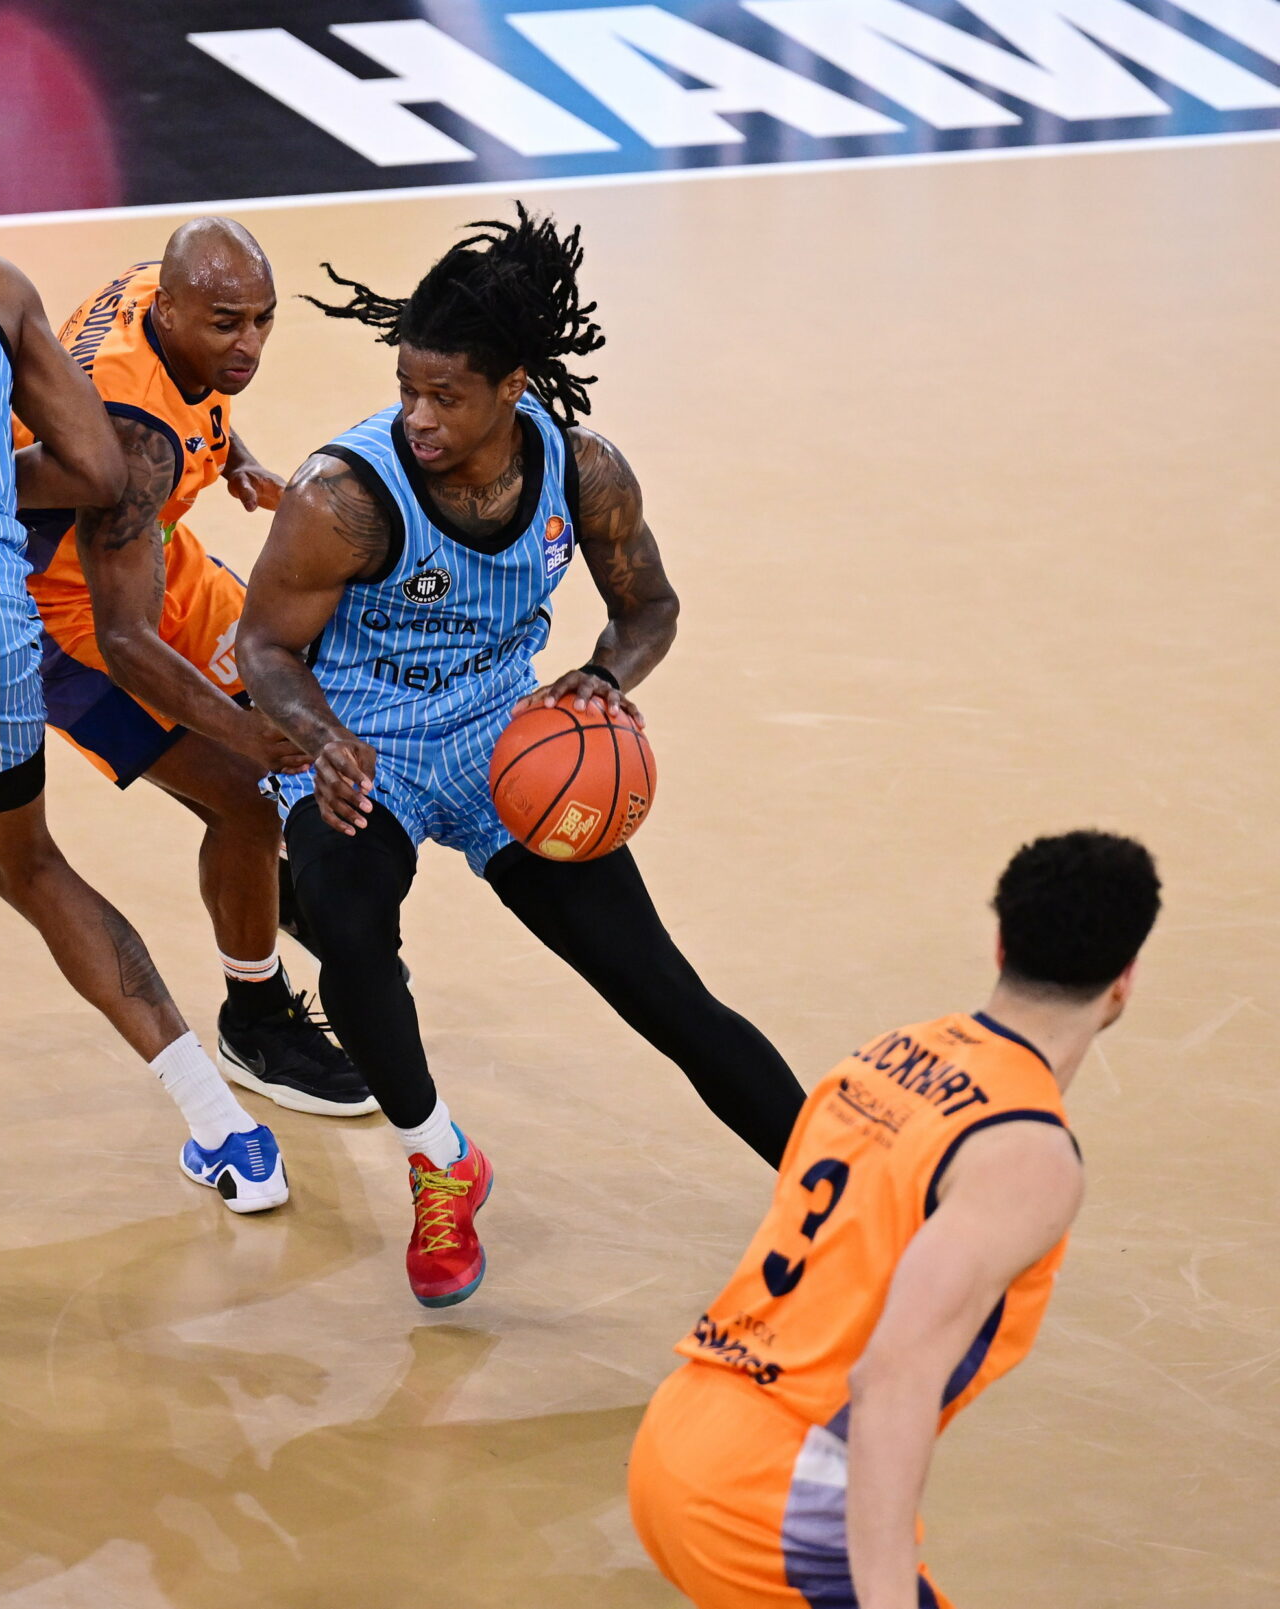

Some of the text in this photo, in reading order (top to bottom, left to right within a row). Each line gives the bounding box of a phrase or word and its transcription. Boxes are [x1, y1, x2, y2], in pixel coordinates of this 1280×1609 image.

[186, 0, 1280, 167] HAM
[547, 551, 568, 572] BBL
[395, 618, 476, 635] VEOLIA
[762, 1158, 849, 1298] 3
